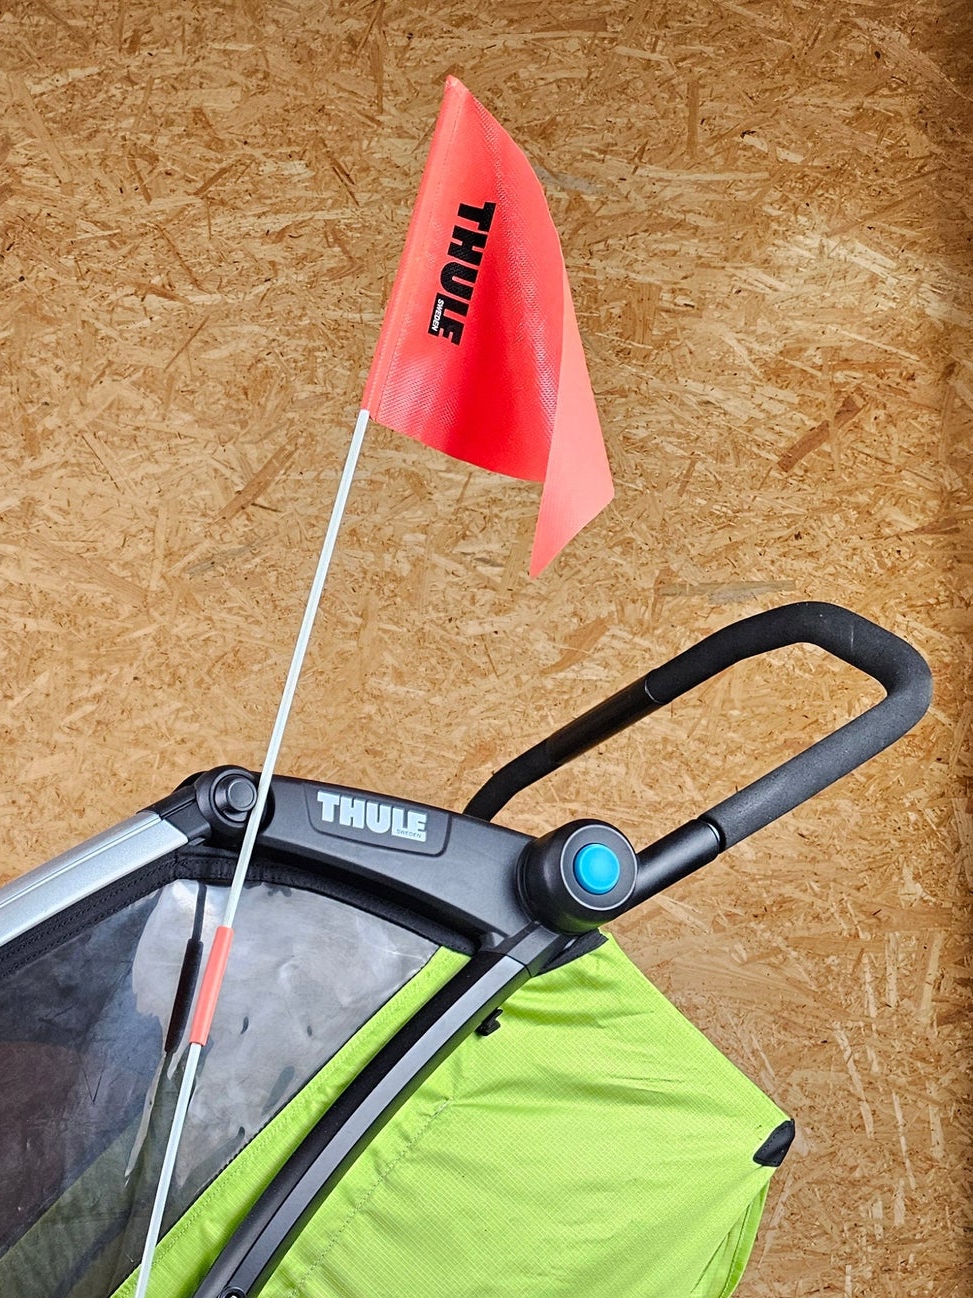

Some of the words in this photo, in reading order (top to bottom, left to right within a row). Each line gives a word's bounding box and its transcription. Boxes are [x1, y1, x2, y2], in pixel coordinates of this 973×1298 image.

[429, 202, 496, 345] THULE
[432, 298, 445, 331] SWEDEN
[317, 791, 427, 842] THULE
[397, 829, 422, 839] SWEDEN
